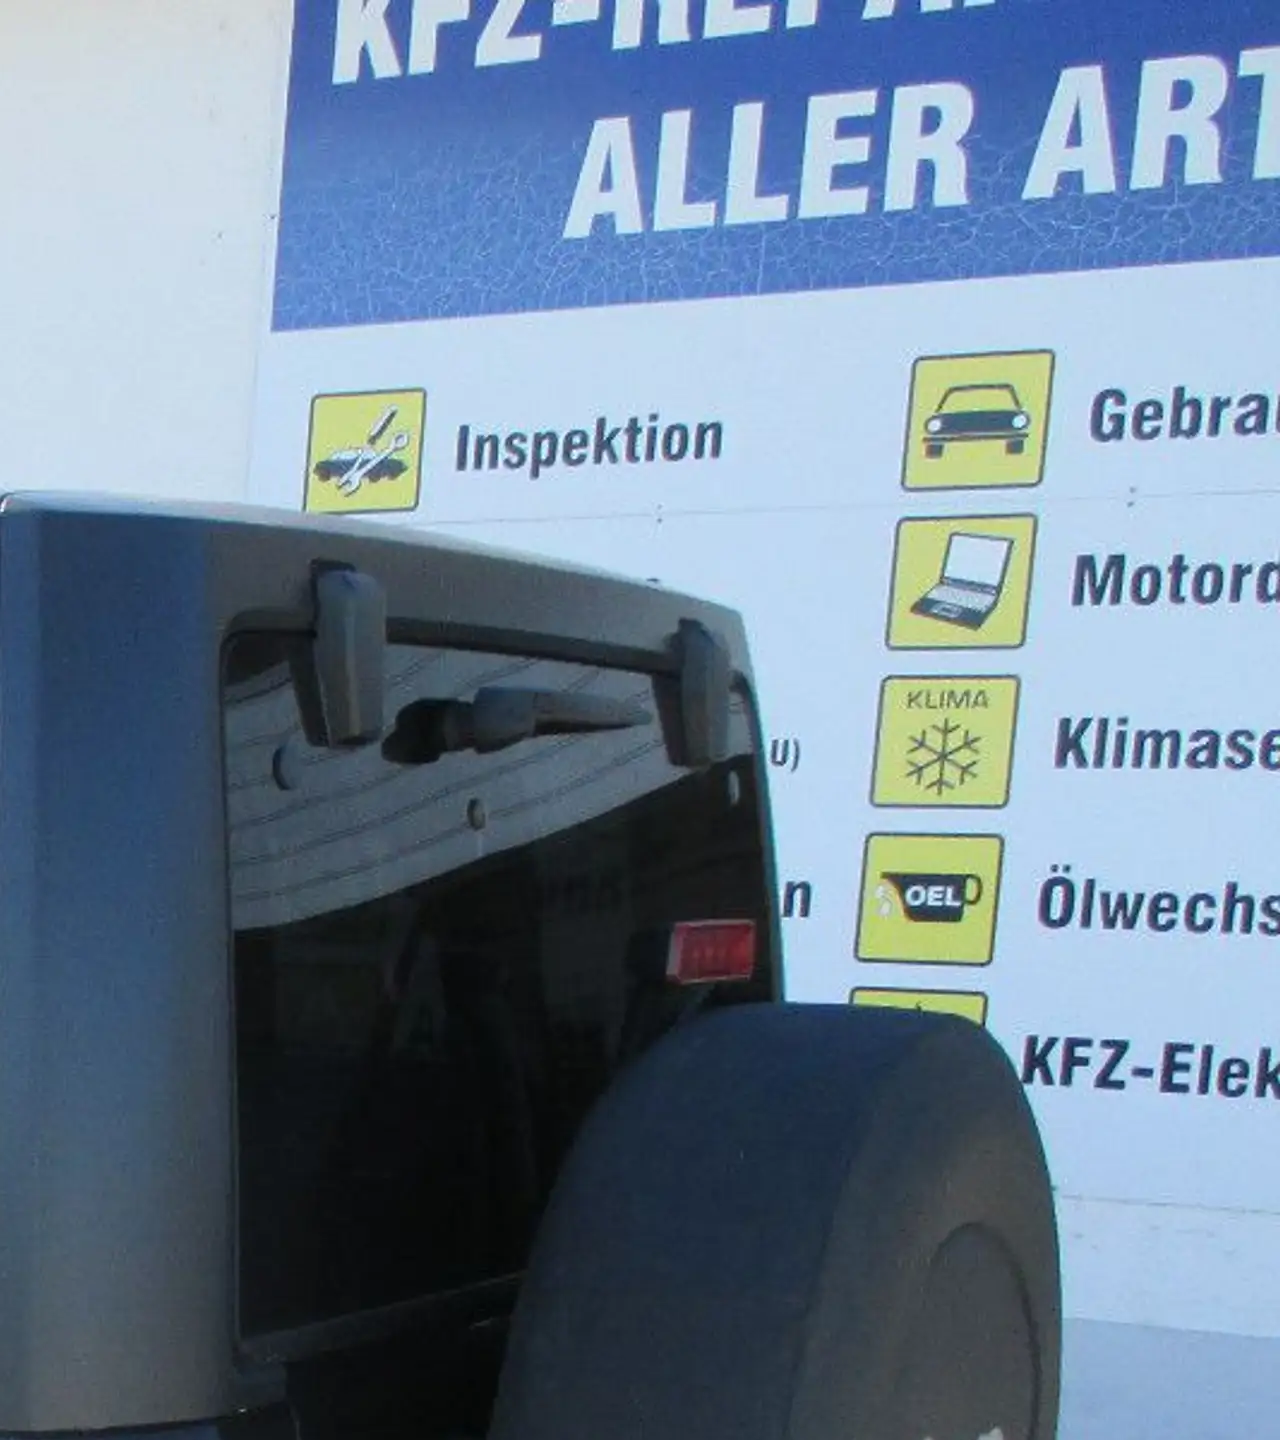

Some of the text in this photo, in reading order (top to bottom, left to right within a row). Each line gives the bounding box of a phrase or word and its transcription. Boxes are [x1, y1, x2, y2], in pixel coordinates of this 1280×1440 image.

[563, 82, 975, 241] ALLER
[1089, 386, 1280, 443] Gebra
[456, 413, 724, 480] Inspektion
[906, 689, 990, 710] KLIMA
[905, 885, 962, 908] OEL
